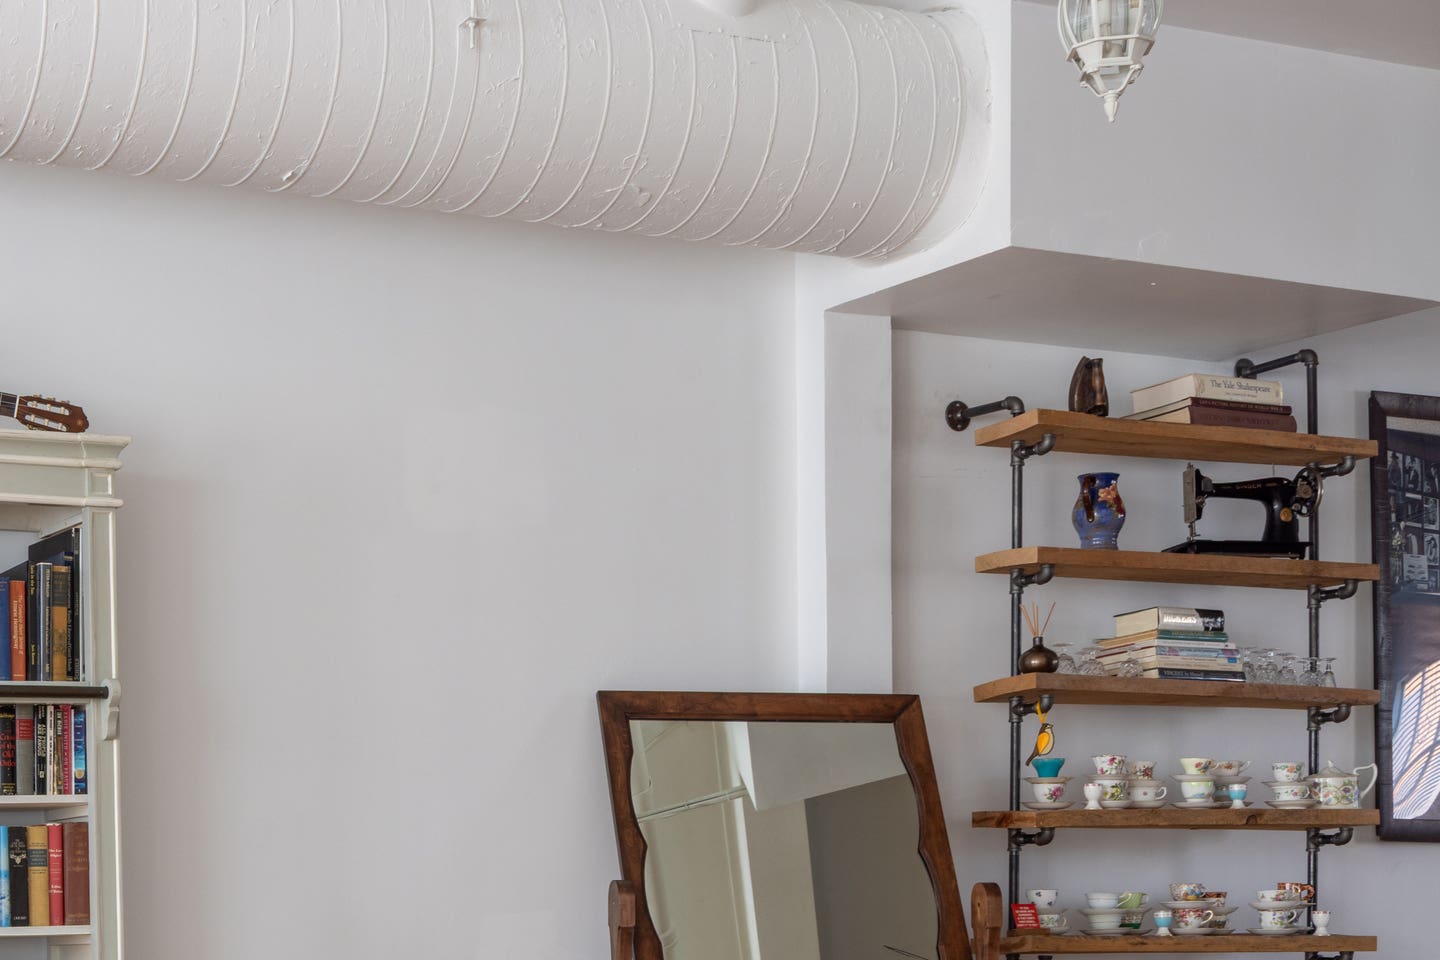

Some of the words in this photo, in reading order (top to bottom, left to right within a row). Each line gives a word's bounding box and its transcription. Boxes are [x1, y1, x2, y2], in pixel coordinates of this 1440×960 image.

[1210, 380, 1222, 388] The
[1222, 381, 1235, 389] Yale
[1236, 382, 1271, 393] Shakespeare
